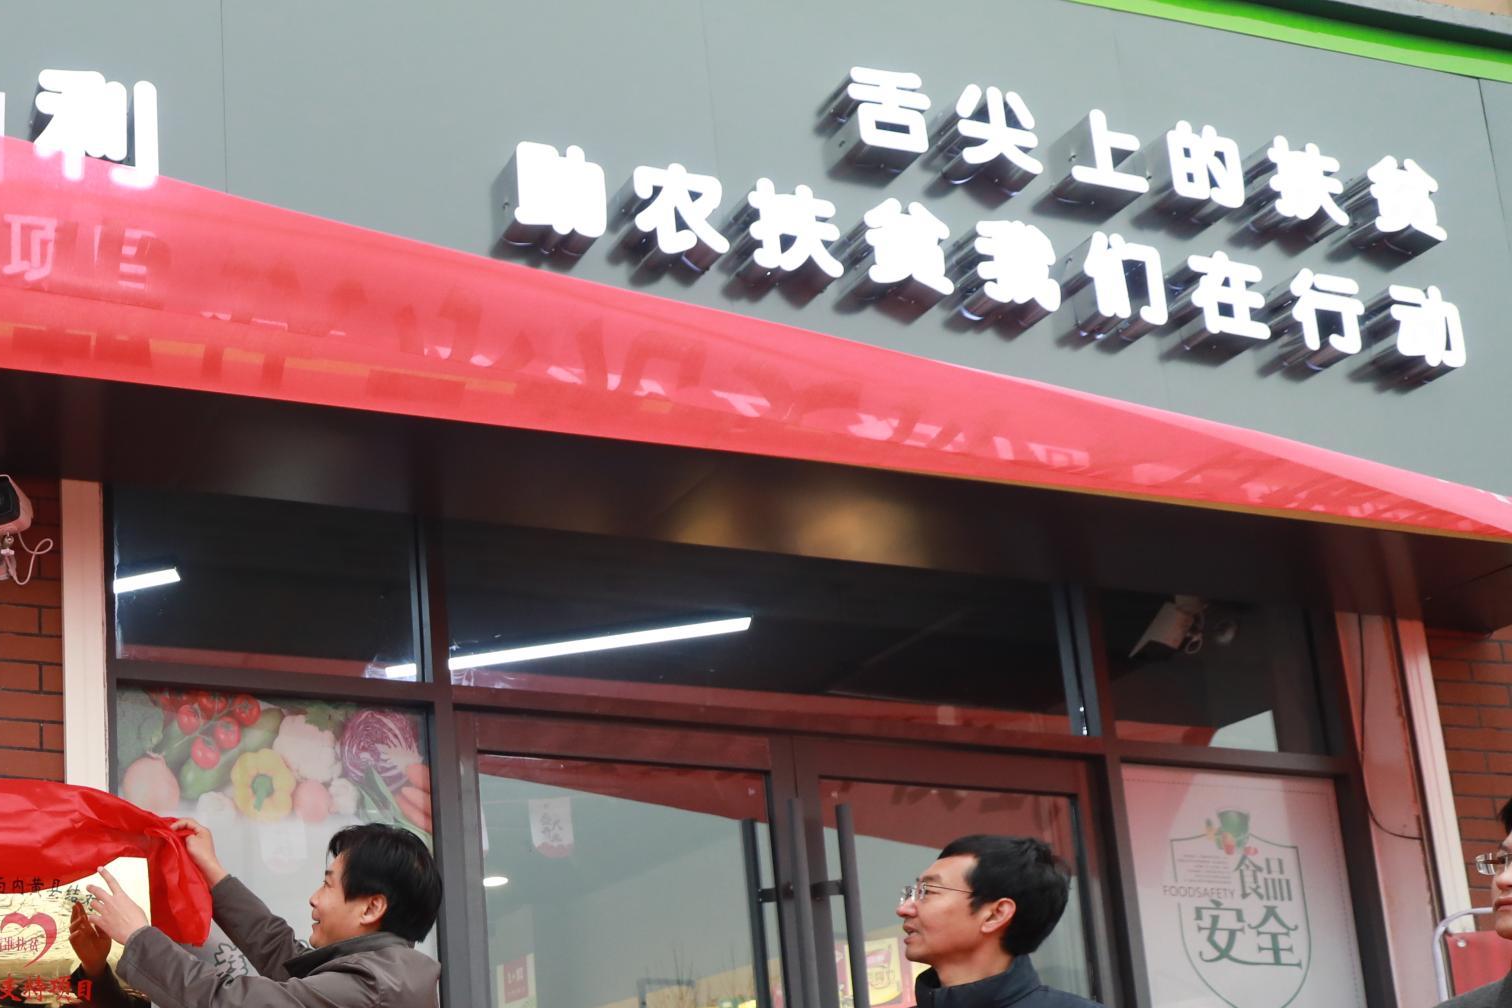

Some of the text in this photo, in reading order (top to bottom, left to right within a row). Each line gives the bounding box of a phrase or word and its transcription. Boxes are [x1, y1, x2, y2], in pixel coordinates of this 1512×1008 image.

[849, 66, 1445, 239] 舌尖上的扶贫
[516, 142, 1465, 368] 助农扶贫我们在行动
[1194, 898, 1303, 969] 安全
